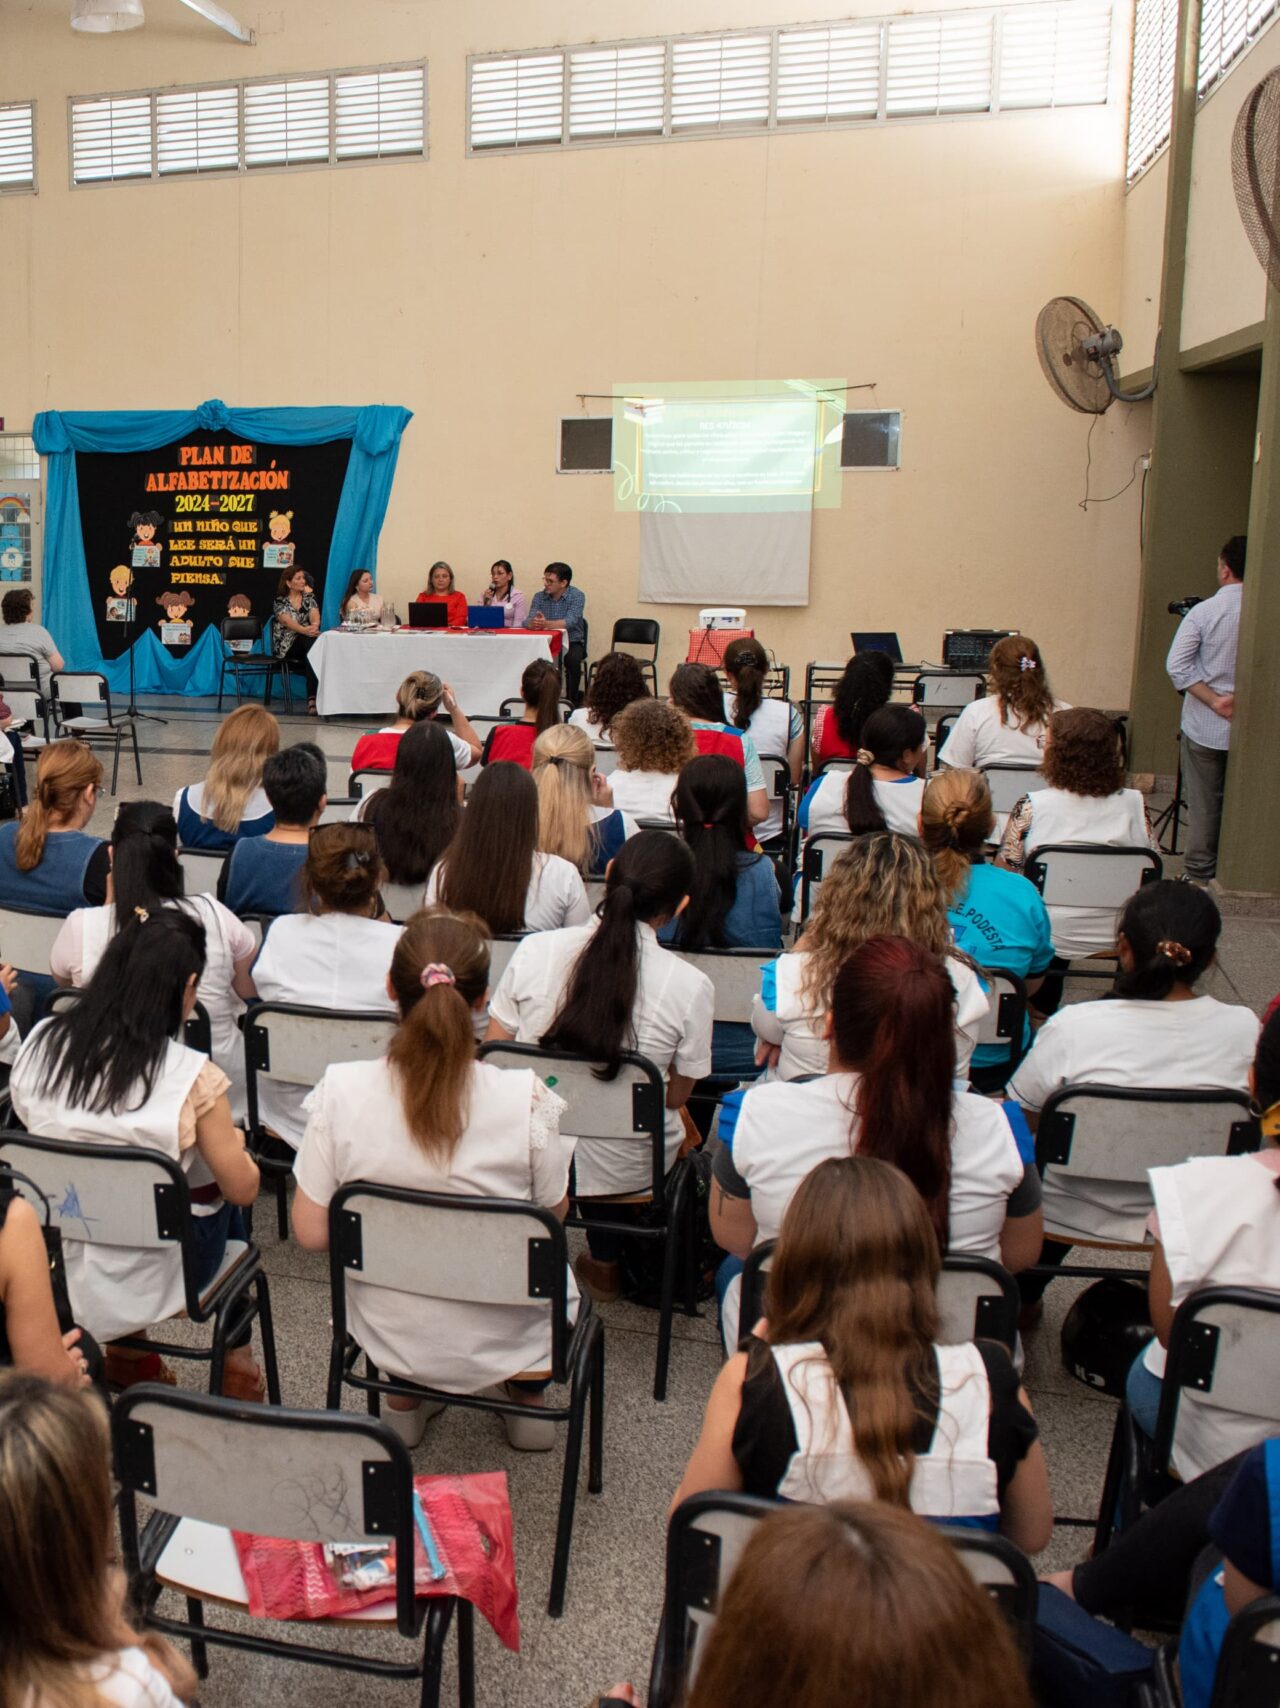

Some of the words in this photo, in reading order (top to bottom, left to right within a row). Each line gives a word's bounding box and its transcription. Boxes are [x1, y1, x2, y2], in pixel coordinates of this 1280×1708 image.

[180, 446, 224, 466] PLAN
[230, 445, 253, 465] DE
[145, 459, 289, 492] ALFABETIZACIÓN
[175, 494, 255, 513] 2024-2027
[231, 520, 258, 533] QUE
[169, 539, 196, 551] LEE
[198, 535, 236, 551] SERÁ
[170, 555, 224, 568] ADULTO
[227, 556, 255, 569] QUE
[171, 572, 224, 585] PIENSA.
